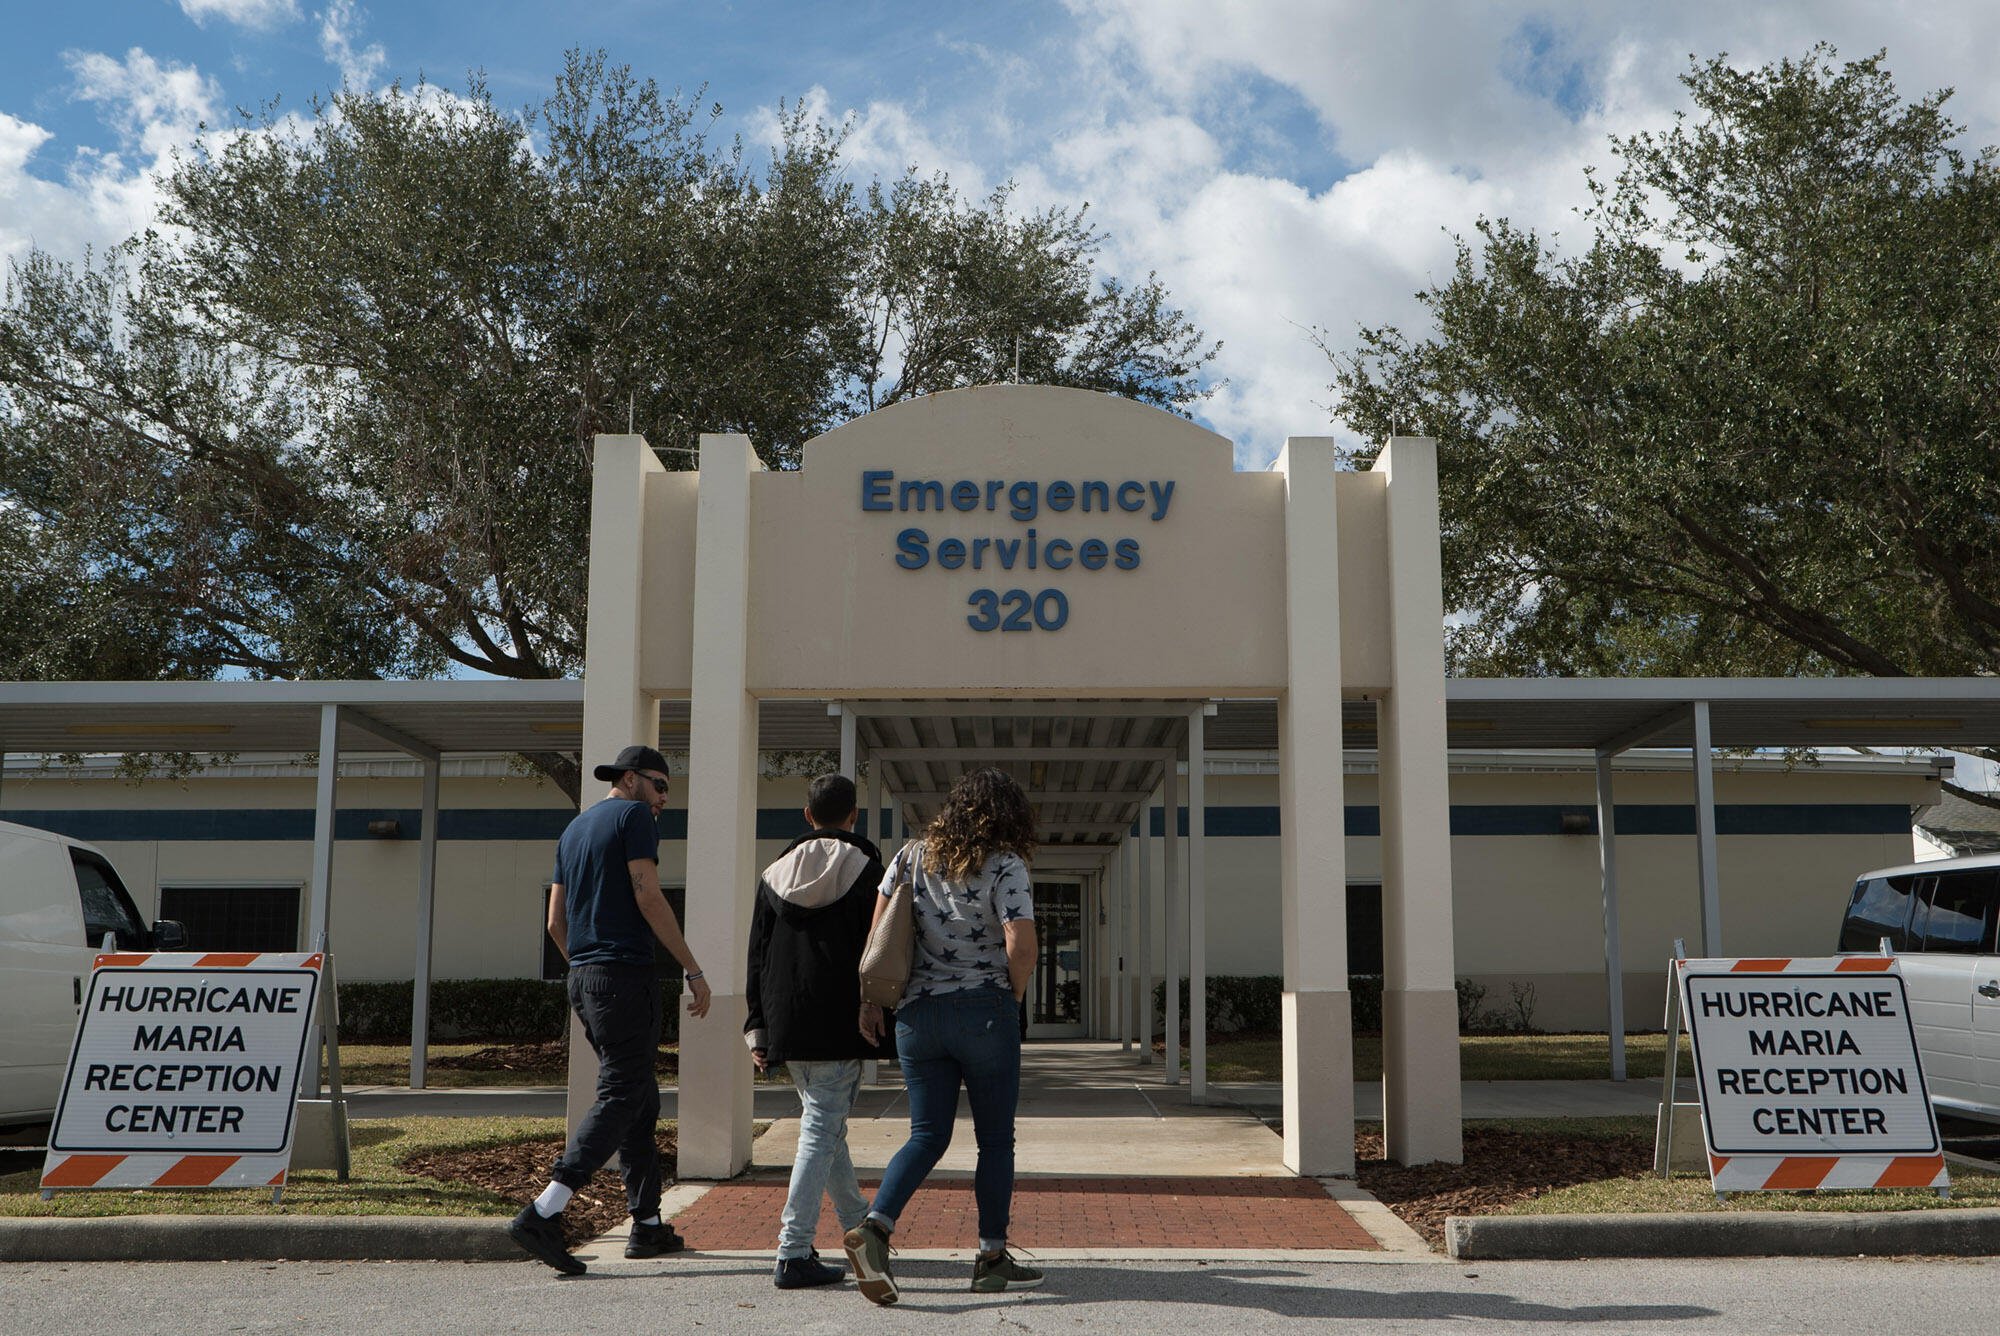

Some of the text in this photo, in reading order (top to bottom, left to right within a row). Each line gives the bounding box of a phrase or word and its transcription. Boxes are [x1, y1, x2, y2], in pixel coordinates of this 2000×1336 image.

[862, 470, 1176, 521] Emergency
[895, 528, 1141, 570] Services
[967, 589, 1069, 632] 320
[98, 986, 301, 1013] HURRICANE
[1701, 992, 1896, 1017] HURRICANE
[133, 1025, 246, 1052] MARIA
[1749, 1030, 1862, 1056] MARIA
[84, 1064, 282, 1092] RECEPTION
[1717, 1068, 1908, 1095] RECEPTION
[105, 1105, 244, 1133] CENTER
[1753, 1108, 1888, 1135] CENTER
